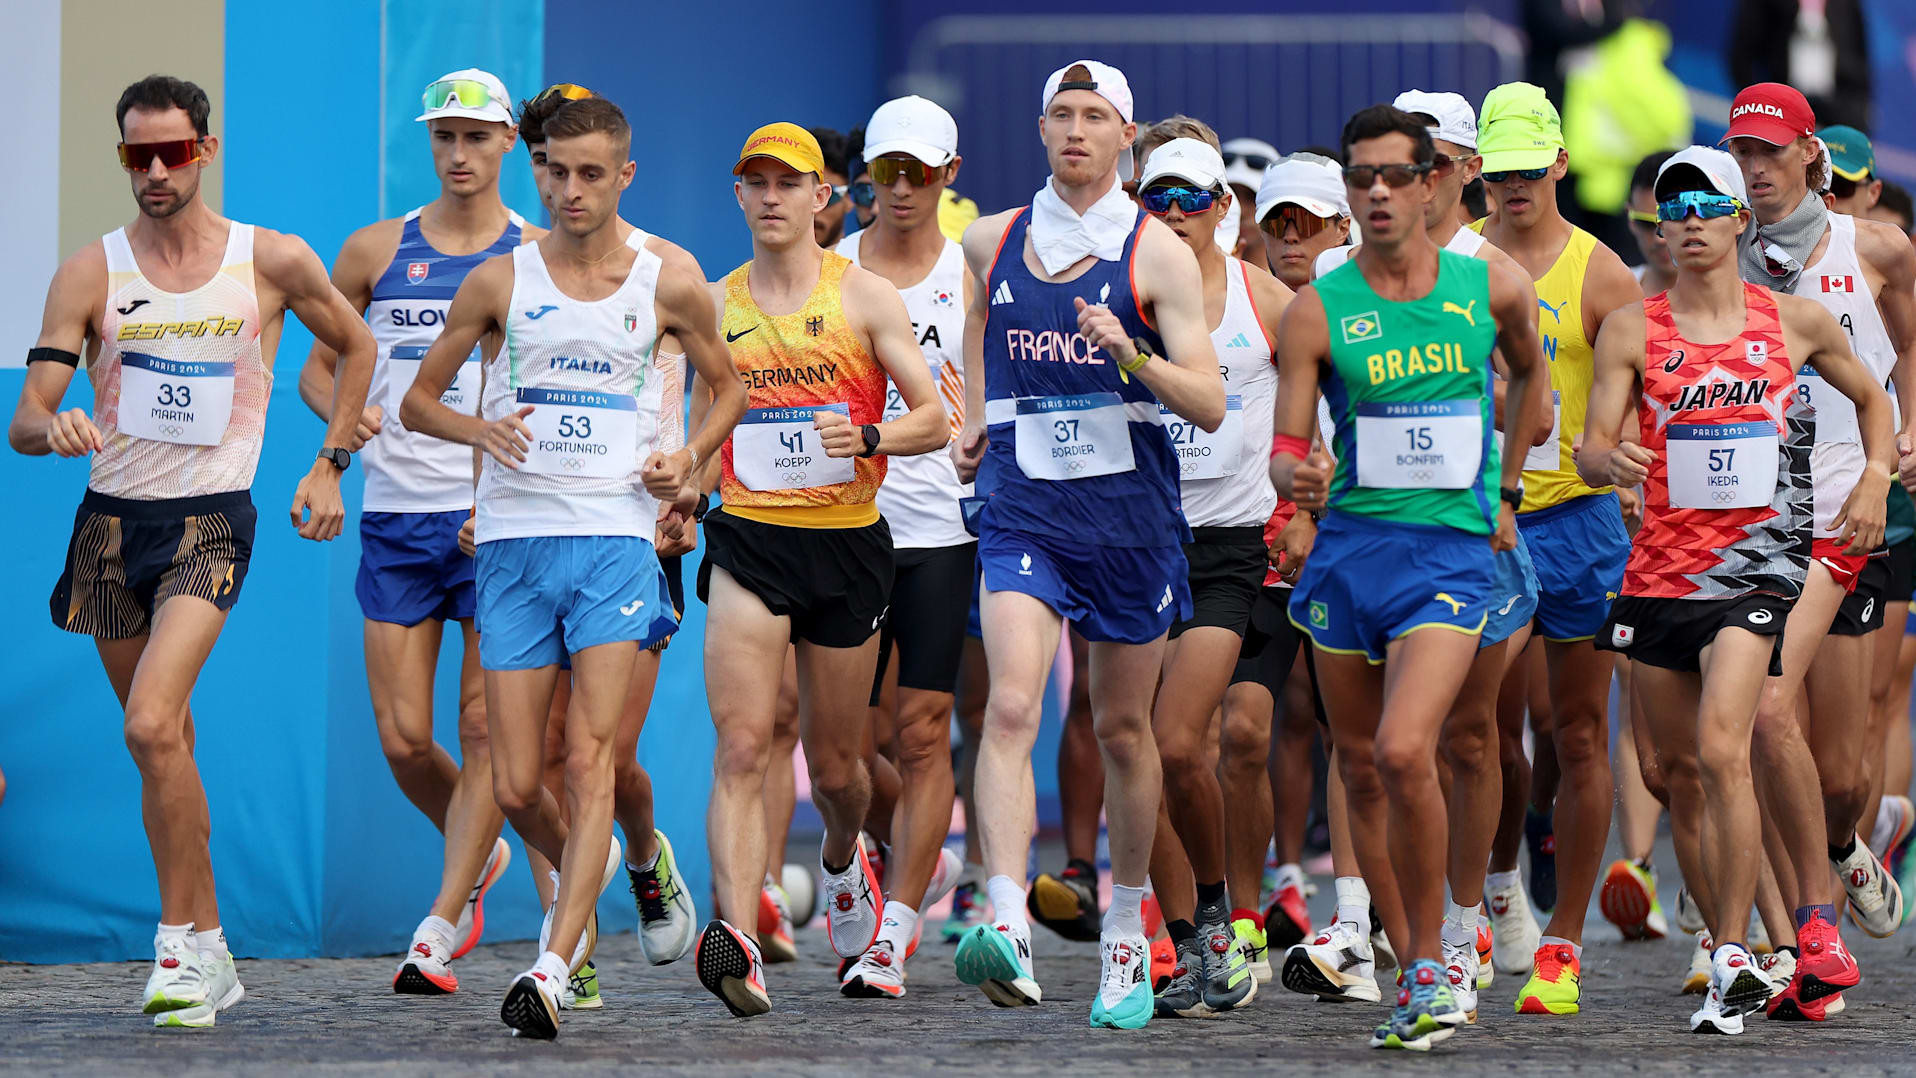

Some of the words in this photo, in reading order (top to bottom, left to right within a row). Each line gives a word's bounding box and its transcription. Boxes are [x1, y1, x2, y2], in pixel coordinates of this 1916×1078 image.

[1732, 102, 1784, 119] CANADA
[747, 135, 800, 152] GERMANY
[117, 316, 245, 341] ESPAÑA
[1006, 329, 1106, 365] FRANCE
[149, 359, 176, 371] PARIS
[179, 365, 207, 374] 2024
[550, 357, 612, 375] ITALIA
[1367, 343, 1471, 385] BRASIL
[740, 363, 837, 390] GERMANY
[157, 383, 192, 408] 33
[546, 393, 576, 403] PARIS
[580, 394, 608, 405] 2024
[1669, 379, 1769, 412] JAPAN
[1037, 401, 1063, 410] PARIS
[1066, 400, 1091, 409] 2024
[1386, 405, 1419, 414] PARIS
[151, 407, 194, 423] MARTIN
[762, 410, 790, 420] PARIS
[558, 415, 592, 439] 53
[1054, 419, 1080, 443] 37
[1692, 428, 1720, 436] PARIS
[1722, 427, 1750, 435] 2024
[779, 430, 804, 453] 41
[1405, 427, 1433, 450] 15
[539, 440, 608, 455] FORTUNATO
[1052, 444, 1095, 458] BORDIER
[774, 456, 812, 468] KOEPP
[1396, 454, 1444, 465] BONFIM
[1708, 448, 1736, 472] 57
[1707, 475, 1739, 487] IKEDA
